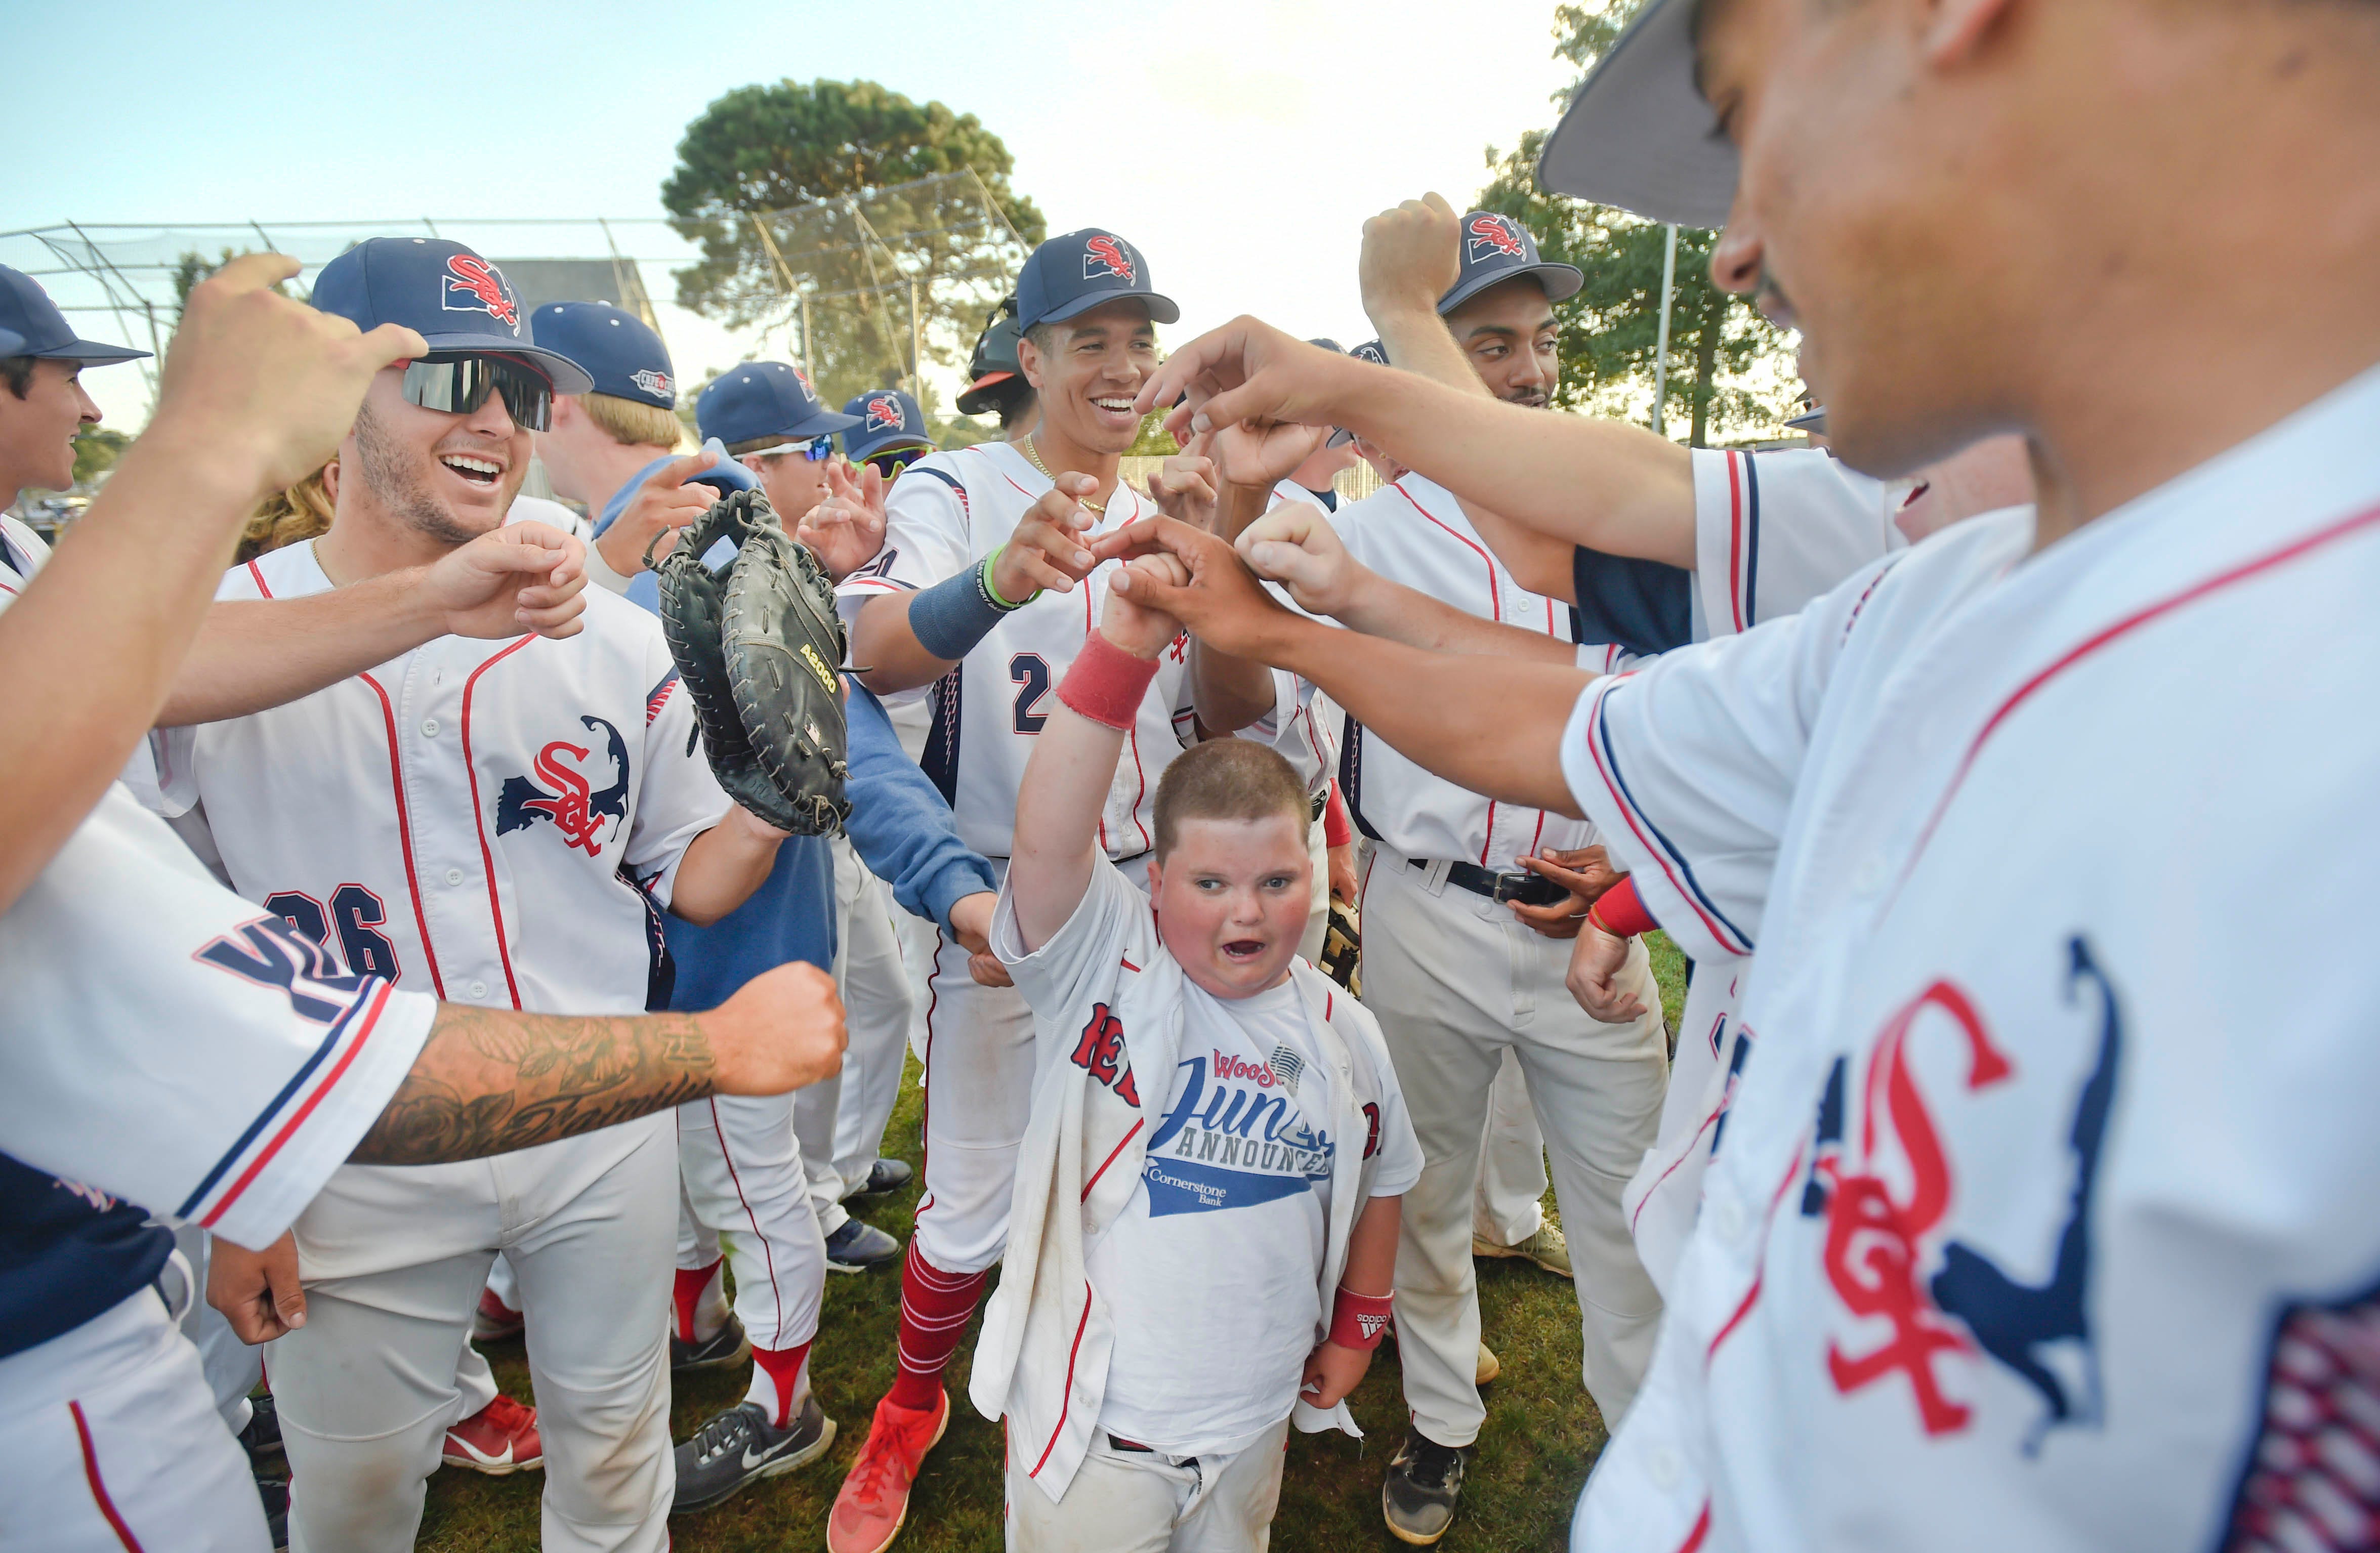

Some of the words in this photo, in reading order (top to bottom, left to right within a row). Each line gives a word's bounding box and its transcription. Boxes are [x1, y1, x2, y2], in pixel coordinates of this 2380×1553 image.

[976, 578, 990, 602] EVERY
[800, 643, 836, 694] A2000
[1009, 652, 1051, 735] 2
[523, 741, 605, 858] Sox
[1149, 1169, 1227, 1198] Cornerstone
[1198, 1194, 1223, 1207] Bank
[1357, 1314, 1387, 1324] adidas
